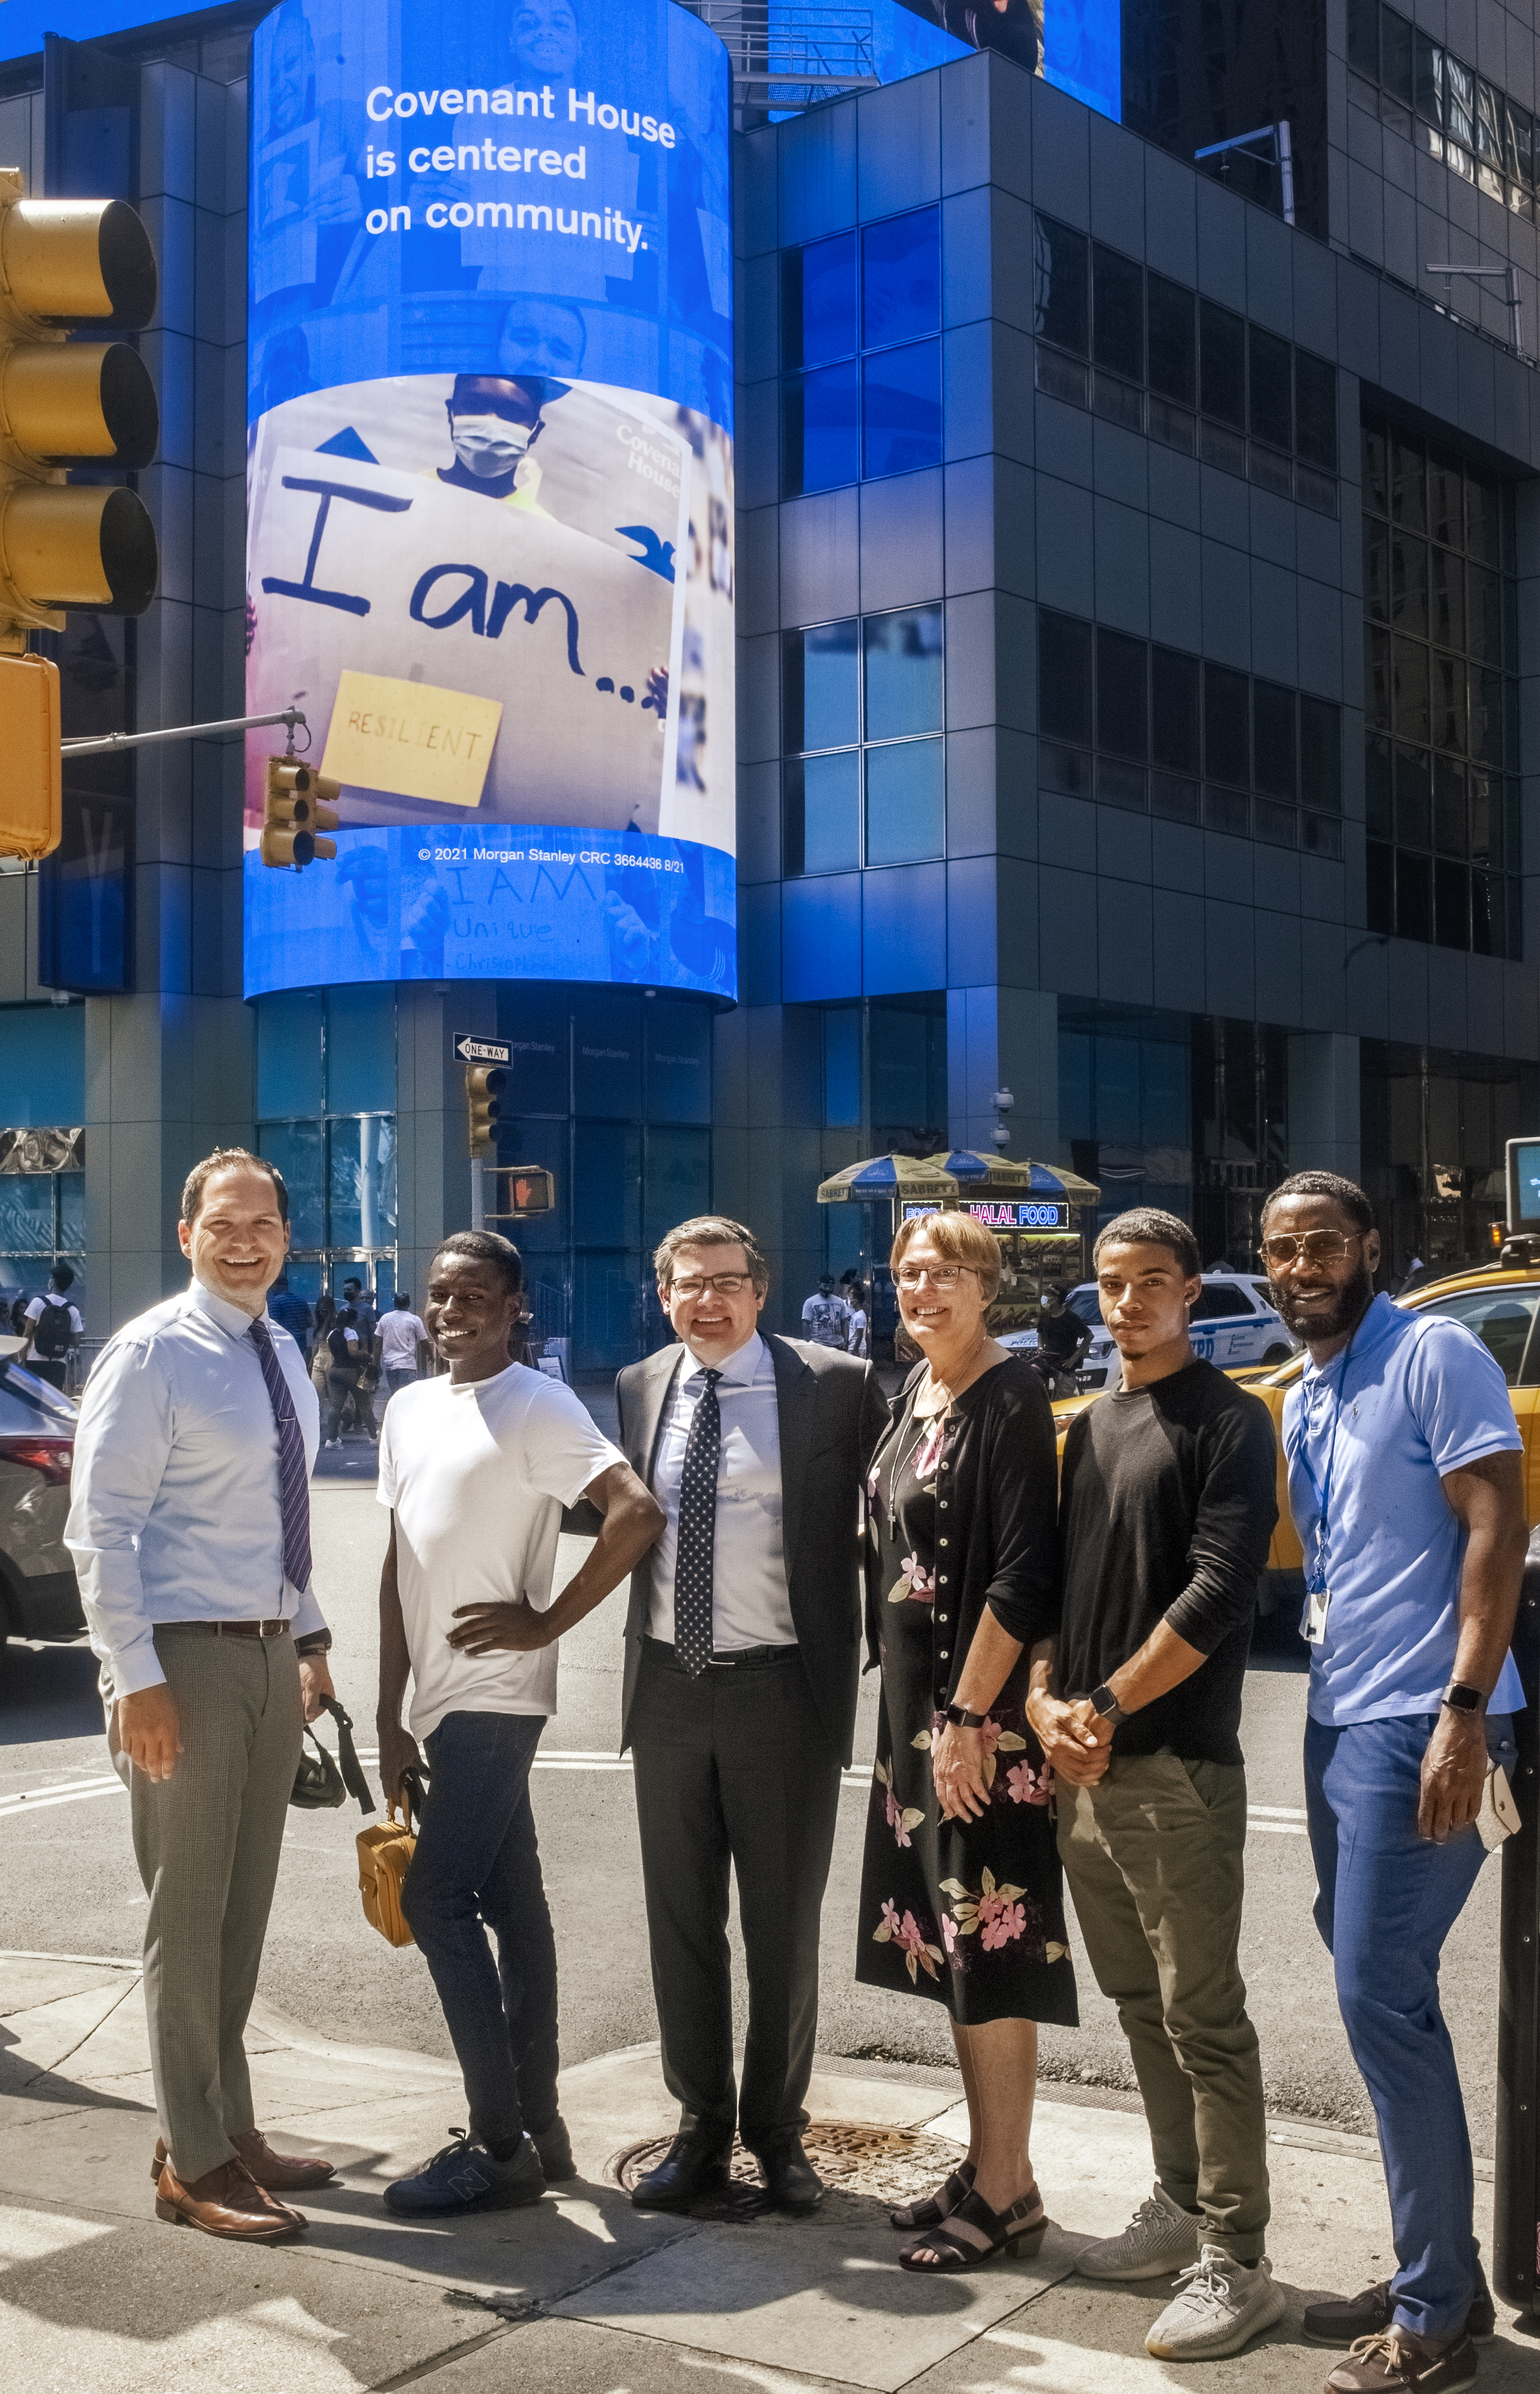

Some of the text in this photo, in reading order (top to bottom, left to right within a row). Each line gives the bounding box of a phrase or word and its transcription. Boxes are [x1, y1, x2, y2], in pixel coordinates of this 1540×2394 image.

[366, 85, 675, 149] Covenant House
[366, 138, 586, 179] is centered
[365, 206, 411, 234] on
[426, 202, 648, 253] community.
[627, 450, 680, 499] House
[262, 475, 414, 617] I
[348, 710, 482, 759] RESILIENT
[435, 847, 467, 860] 2021
[473, 847, 524, 863] Morgan
[529, 848, 576, 865] Stanley
[580, 850, 611, 865] CRC
[614, 854, 662, 870] 3664436
[664, 860, 685, 873] 8/21
[465, 1043, 505, 1060] ONE WAY
[512, 1041, 556, 1055] organ Stanley
[582, 1047, 630, 1061] Morgan Stanley
[970, 1204, 1058, 1225] HALAL FOOD
